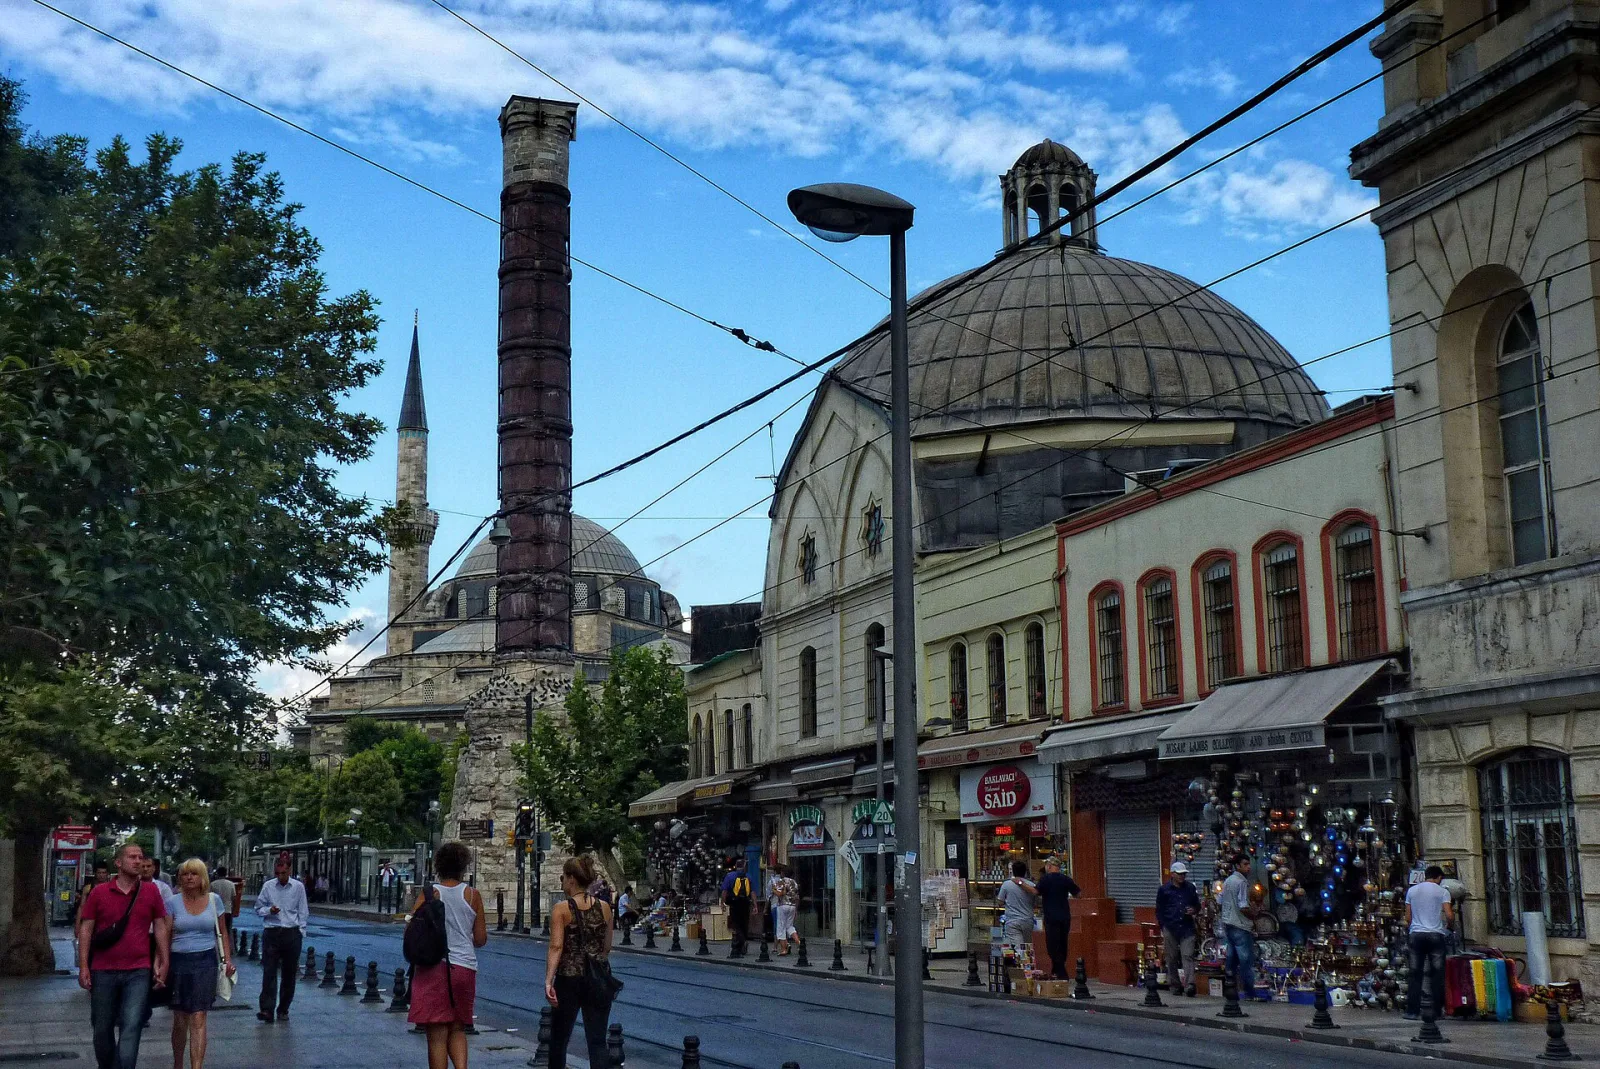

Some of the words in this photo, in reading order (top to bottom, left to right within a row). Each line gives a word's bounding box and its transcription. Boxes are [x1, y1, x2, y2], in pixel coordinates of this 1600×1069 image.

[1250, 735, 1263, 747] AND
[1290, 730, 1313, 744] CENTER
[984, 773, 1015, 785] BAKLAVACI
[984, 789, 1017, 809] SAİD
[877, 811, 889, 821] 20
[1413, 872, 1424, 884] 20
